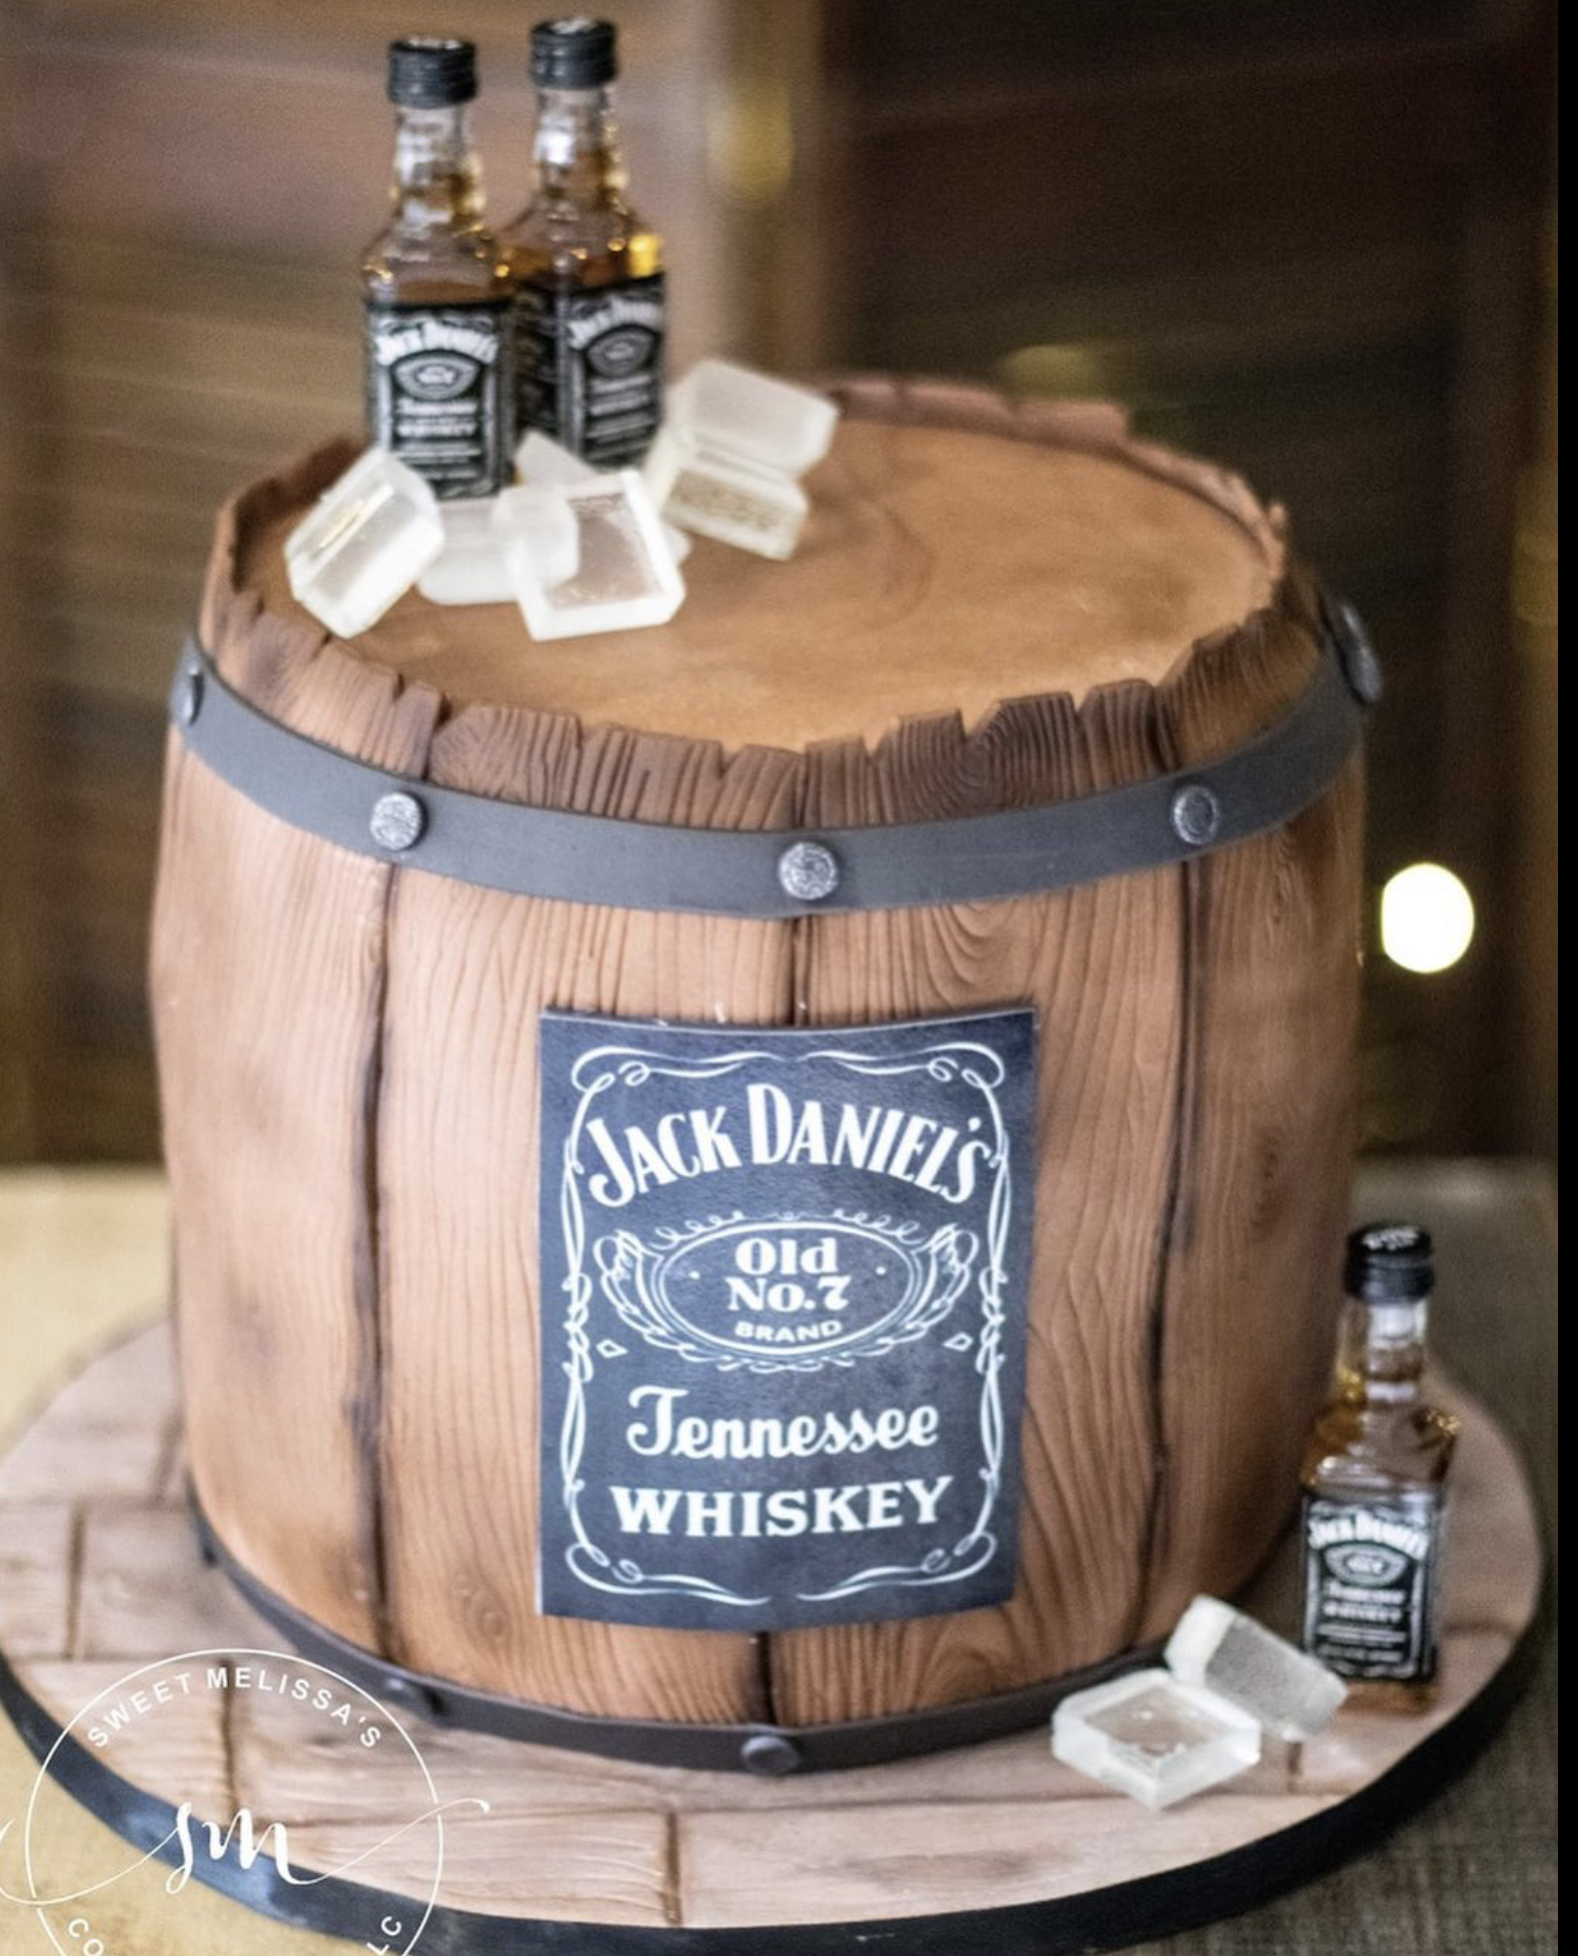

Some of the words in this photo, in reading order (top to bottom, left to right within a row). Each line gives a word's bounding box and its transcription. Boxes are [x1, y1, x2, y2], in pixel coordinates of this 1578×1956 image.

[586, 1106, 743, 1208] JACK
[746, 1083, 993, 1203] DANIEL'S
[735, 1237, 838, 1275] Old
[734, 1320, 843, 1343] BRAND
[626, 1385, 939, 1459] Tennessee
[609, 1475, 954, 1537] WHISKEY
